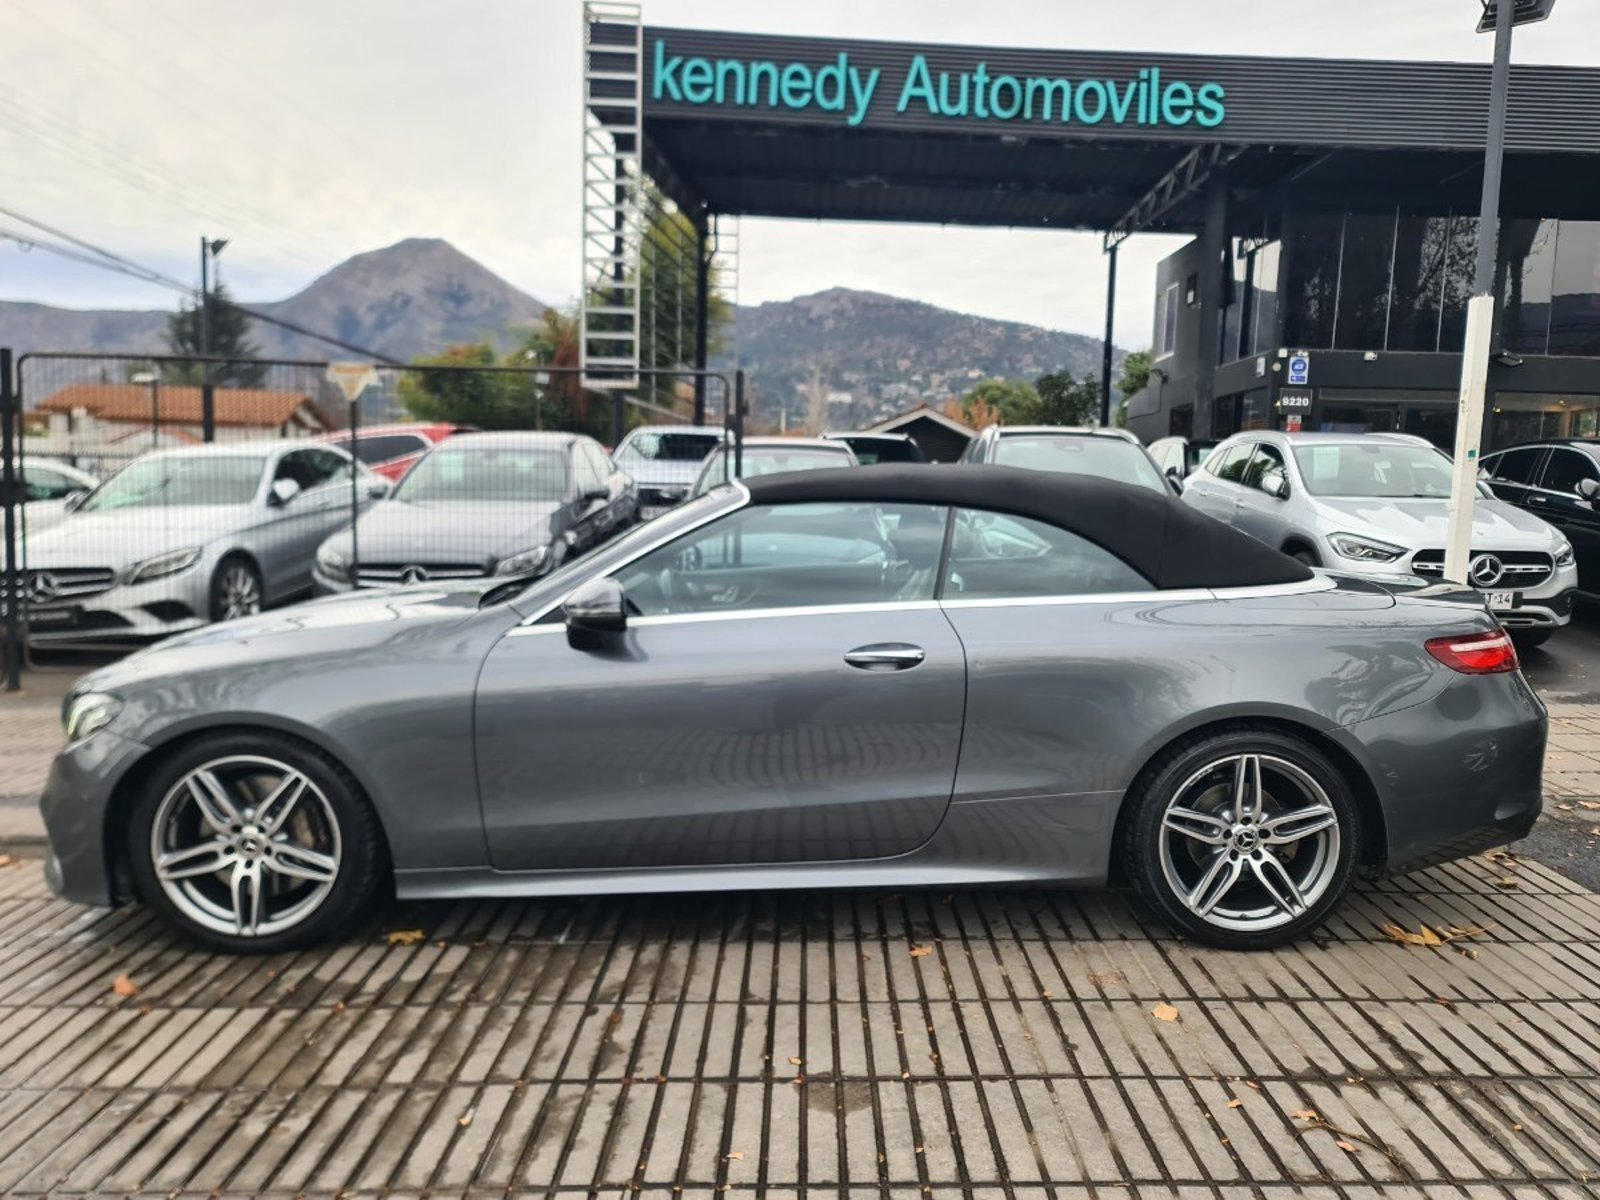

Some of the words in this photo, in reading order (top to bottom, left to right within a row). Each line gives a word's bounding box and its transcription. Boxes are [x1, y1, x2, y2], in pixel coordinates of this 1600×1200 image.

[653, 39, 881, 126] kennedy
[896, 55, 1226, 127] Automoviles
[1282, 396, 1309, 406] 9220
